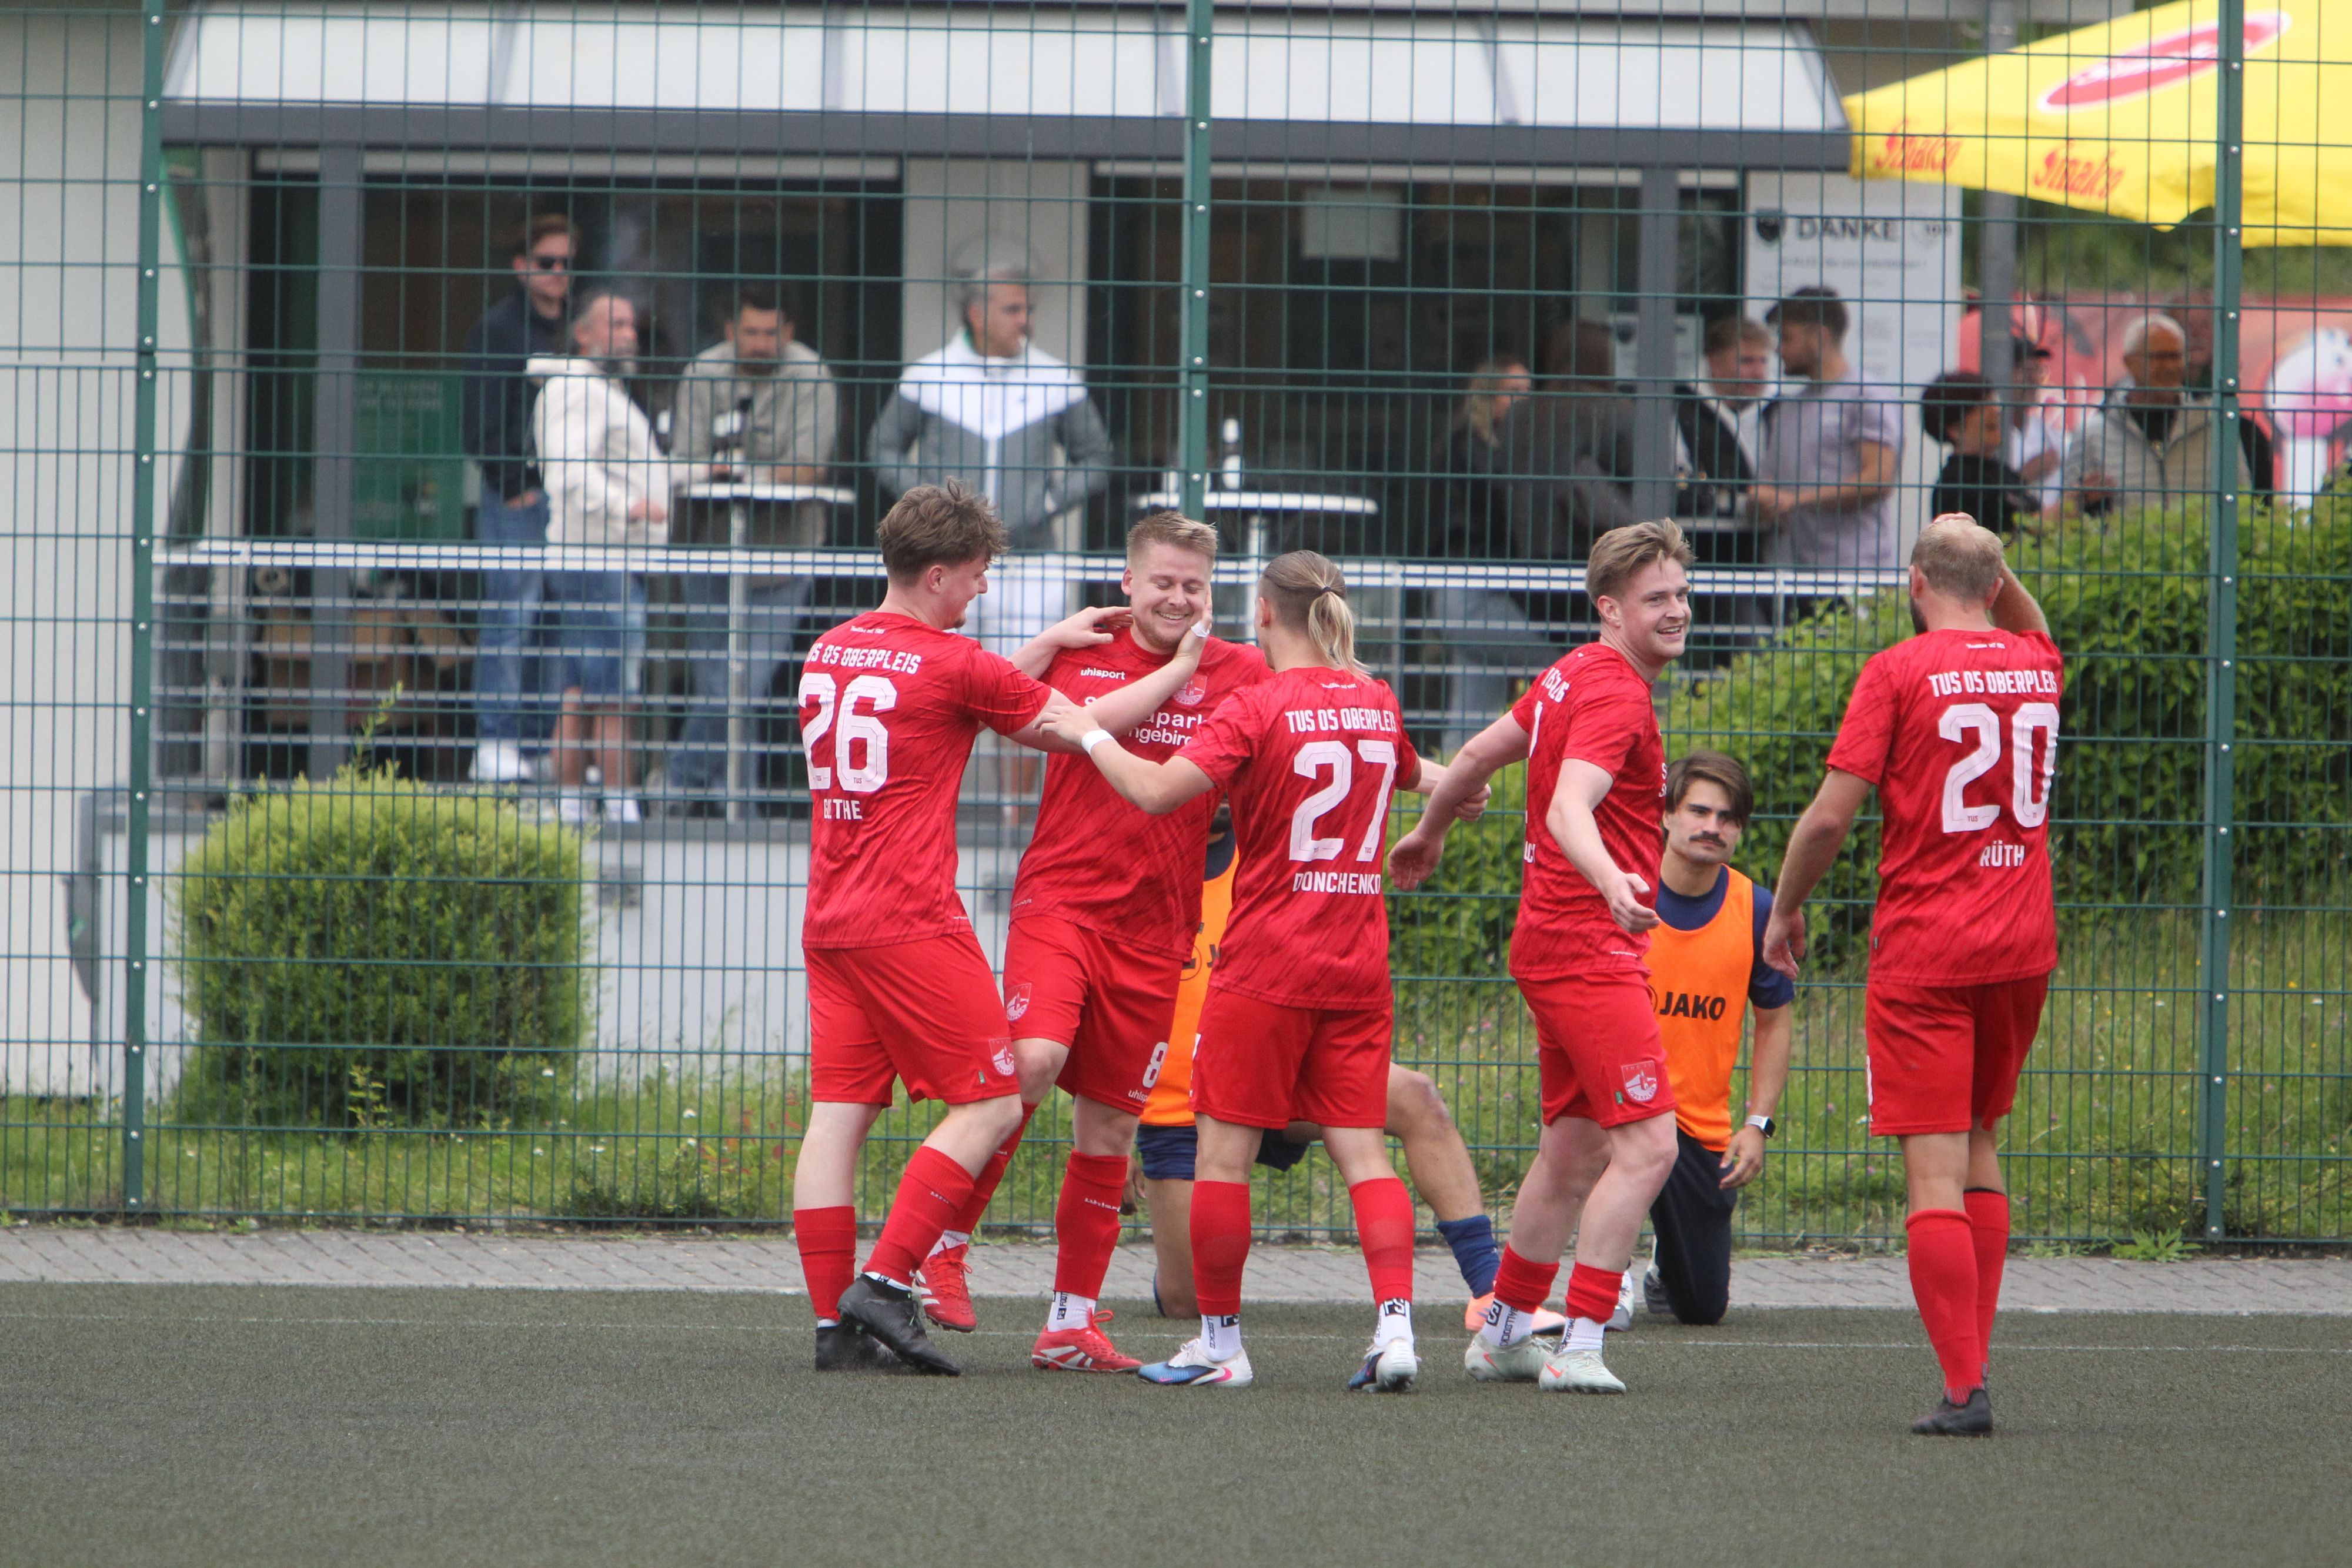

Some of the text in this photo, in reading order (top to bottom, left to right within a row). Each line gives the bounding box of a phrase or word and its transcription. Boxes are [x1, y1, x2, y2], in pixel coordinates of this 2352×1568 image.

[1797, 216, 1899, 242] DANKE
[806, 642, 921, 674] US 05 OBERPLEIS
[1080, 667, 1125, 680] uhlsport
[1929, 671, 1963, 697] TUS
[1963, 671, 1984, 693] 05
[798, 673, 897, 792] 26
[1285, 709, 1316, 733] TUS
[1317, 708, 1339, 731] 05
[1938, 703, 2060, 833] 20
[1289, 740, 1398, 862] 27
[1980, 839, 2025, 867] RÜTH
[1292, 871, 1382, 894] DONCHENKO
[1659, 991, 1726, 1021] JAKO
[1142, 1041, 1168, 1088] 8
[1128, 1089, 1148, 1103] uhlsp
